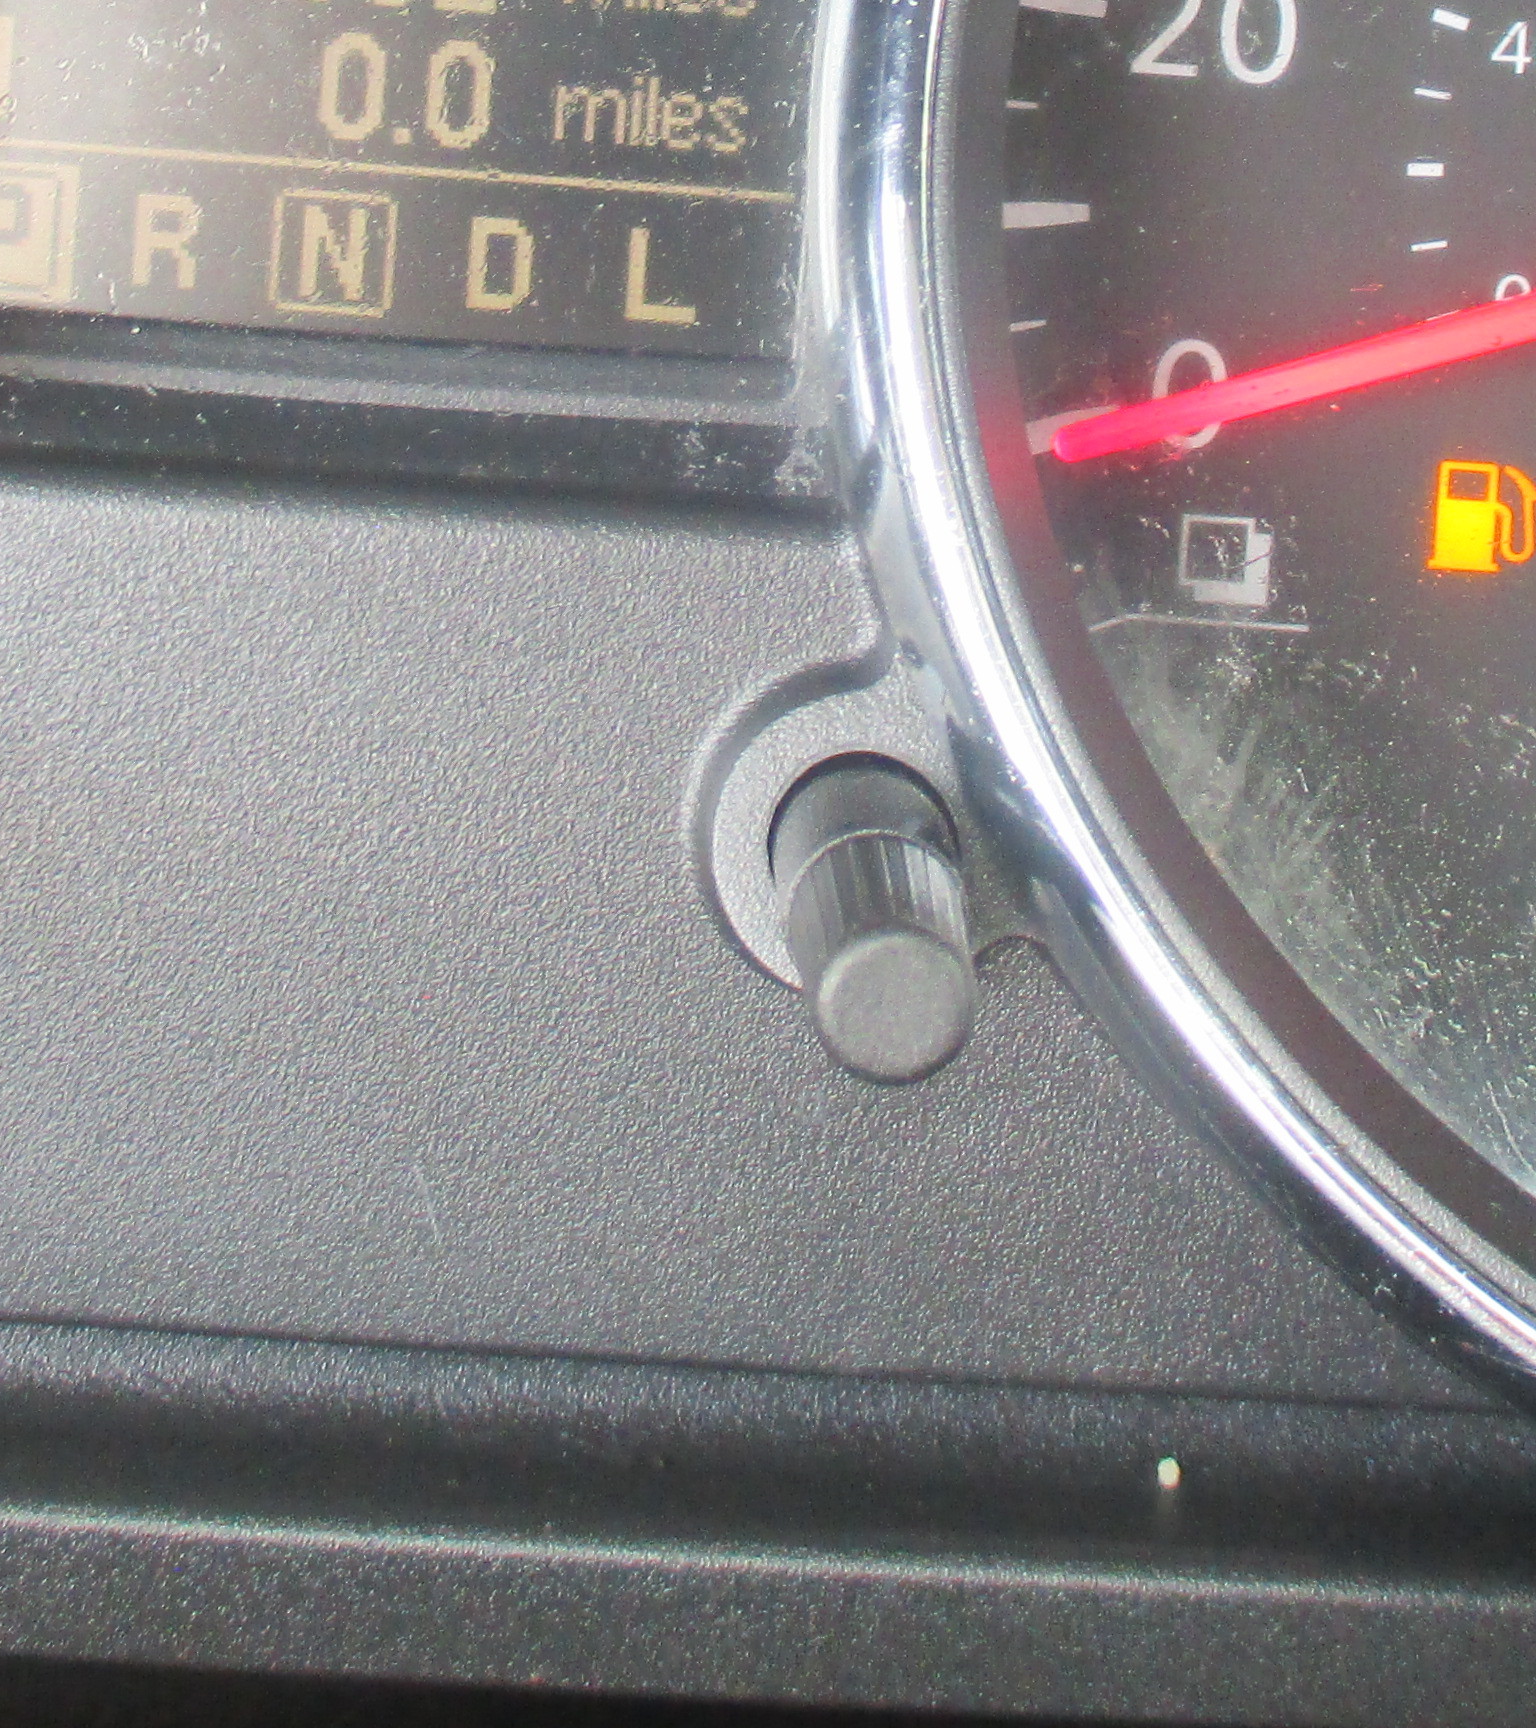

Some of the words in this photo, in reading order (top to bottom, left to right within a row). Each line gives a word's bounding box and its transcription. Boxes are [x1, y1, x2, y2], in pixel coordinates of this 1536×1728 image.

[320, 32, 495, 149] 0.0
[553, 77, 748, 154] miles
[132, 193, 201, 288] R
[300, 205, 364, 299] N
[466, 216, 533, 312] D
[625, 228, 698, 326] L
